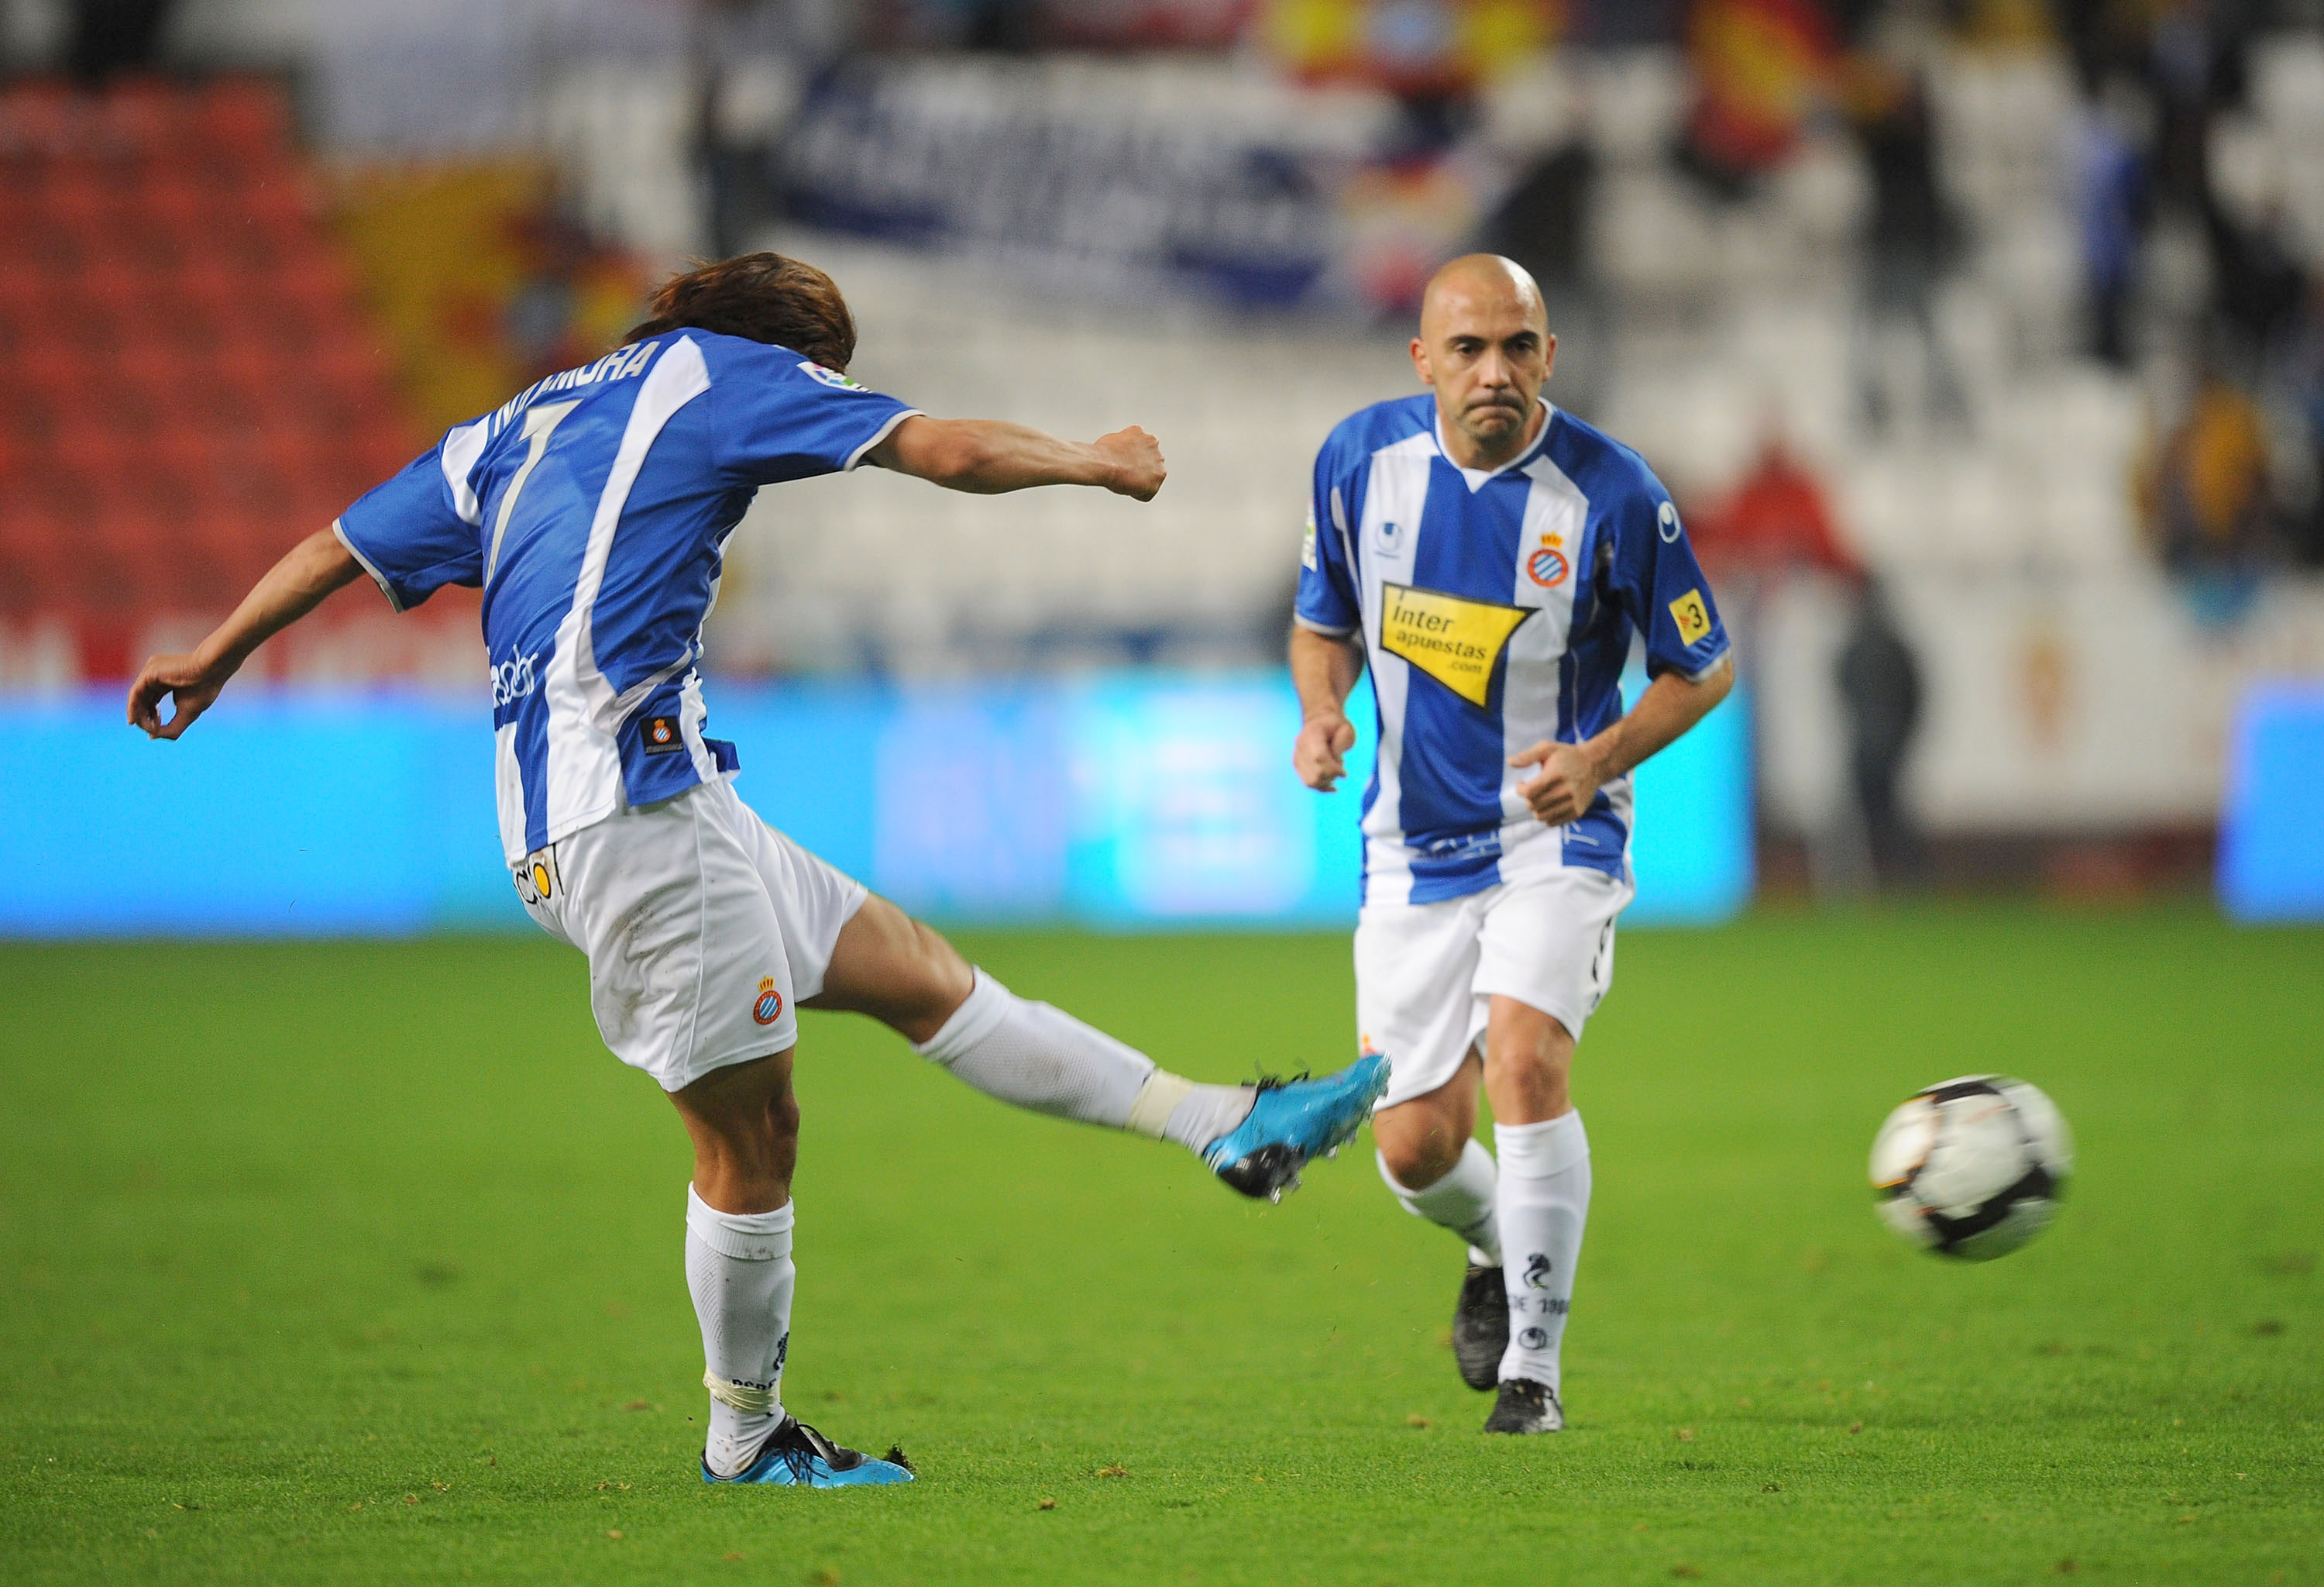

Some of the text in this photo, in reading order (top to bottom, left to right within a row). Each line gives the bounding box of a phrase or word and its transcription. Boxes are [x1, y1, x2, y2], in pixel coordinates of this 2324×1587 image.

[485, 398, 585, 590] 7
[1688, 604, 1703, 628] 3
[1396, 629, 1487, 660] apuestas
